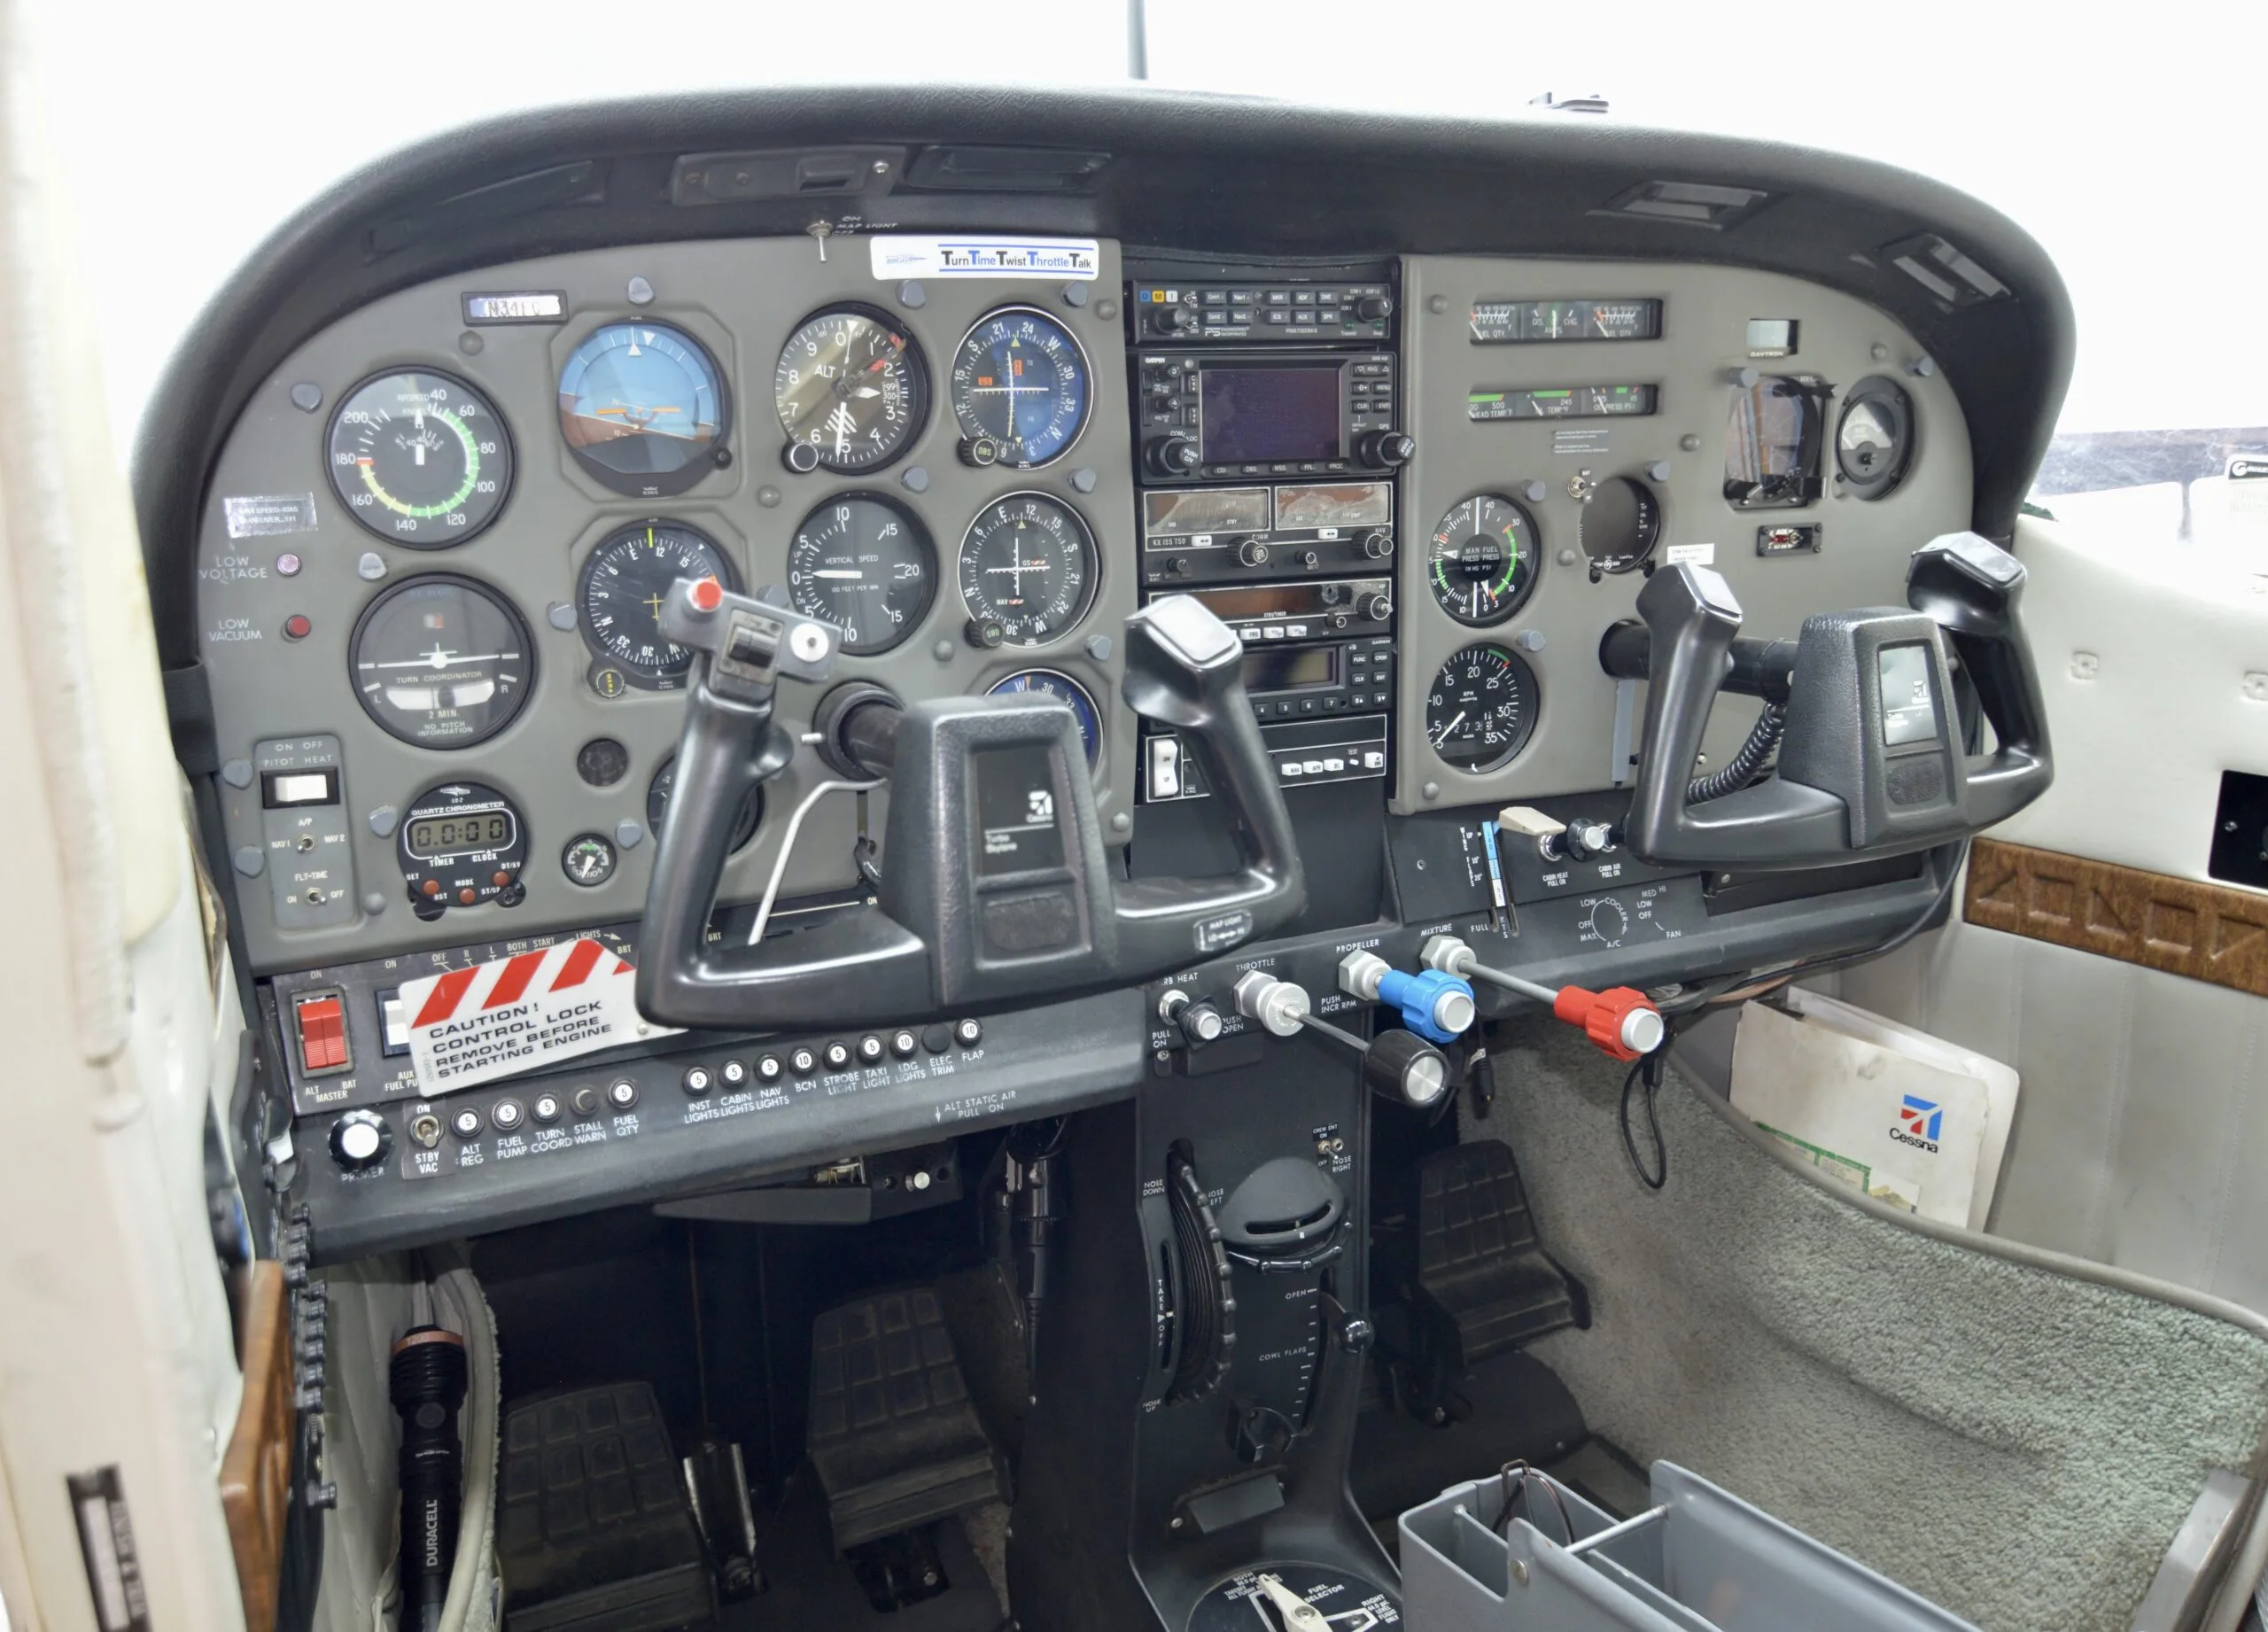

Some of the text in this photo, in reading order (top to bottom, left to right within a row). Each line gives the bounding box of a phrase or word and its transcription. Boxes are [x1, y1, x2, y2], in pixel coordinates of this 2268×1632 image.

[942, 250, 968, 267] Turn
[968, 250, 996, 266] Time
[996, 251, 1026, 267] Twist
[1027, 252, 1069, 267] Throttle
[1068, 253, 1091, 269] Talk
[992, 322, 1034, 335] 21 24
[807, 342, 817, 356] 9
[788, 370, 799, 384] 8
[815, 364, 836, 378] ALT
[430, 389, 447, 400] 40
[460, 405, 475, 416] 60
[344, 411, 369, 424] 200
[480, 442, 496, 454] 80
[978, 447, 991, 456] OBS
[336, 453, 356, 465] 180
[478, 481, 495, 493] 100
[352, 494, 373, 506] 160
[836, 507, 850, 521] 10
[1025, 504, 1037, 515] 12
[396, 519, 416, 531] 140
[447, 514, 466, 525] 120
[886, 524, 897, 536] 15
[215, 556, 249, 567] LOW
[679, 556, 690, 568] 15
[198, 567, 268, 579] VOLTAGE
[905, 563, 920, 577] 20
[218, 618, 250, 629] LOW
[209, 630, 263, 641] VACUUM
[423, 671, 482, 681] COORDINATOR
[1468, 666, 1480, 678] 20
[1445, 675, 1454, 686] 15
[1486, 677, 1499, 689] 25
[375, 695, 381, 703] L
[429, 711, 434, 719] 2
[1496, 706, 1511, 718] 30
[417, 727, 473, 736] INFORMATION
[423, 722, 436, 731] NO
[1484, 732, 1498, 743] 35
[276, 741, 323, 751] ON OFF
[264, 755, 332, 766] PITOT HEAT
[411, 801, 505, 816] QUARTZ CHRONOMETER
[298, 818, 312, 828] A/P
[429, 857, 454, 867] TIMER
[471, 853, 497, 863] CLOCK
[294, 870, 328, 881] FLT-TIME
[407, 873, 419, 882] SET
[330, 890, 345, 899] OFF
[1642, 889, 1657, 898] MED
[1580, 898, 1596, 908] LOW
[1604, 897, 1628, 922] COOLER
[1638, 911, 1652, 920] OFF
[1421, 923, 1453, 936] MIXTURE
[1471, 923, 1489, 933] FULL
[576, 930, 601, 940] LIGHTS
[1666, 930, 1682, 939] FAN
[507, 942, 527, 952] BOTH
[533, 937, 555, 948] START
[1336, 938, 1379, 953] PROPELLER
[1606, 939, 1621, 948] A/C
[617, 944, 632, 954] BRT
[385, 960, 397, 968] ON
[432, 953, 447, 963] OFF
[1236, 958, 1276, 972] THROTTLE
[310, 970, 322, 979] ON
[1177, 973, 1198, 983] HEAT
[1321, 995, 1340, 1006] PUSH
[1321, 999, 1357, 1014] INCR RPM
[430, 1007, 529, 1038] CAUTION
[432, 1000, 602, 1053] CONTROL LOCK
[436, 1016, 601, 1067] REMOVE BEFORE
[439, 1045, 533, 1078] STARTING
[543, 1023, 611, 1049] ENGINE
[961, 1049, 984, 1061] FLAP
[898, 1062, 918, 1072] LDG
[929, 1055, 952, 1067] ELEC
[398, 1070, 415, 1080] AUX
[865, 1068, 887, 1078] TAXI
[932, 1065, 954, 1076] TRIM
[823, 1071, 860, 1086] STROBE
[306, 1079, 356, 1096] ALT BAT
[384, 1080, 404, 1092] FUEL
[760, 1086, 781, 1098] NAV
[795, 1080, 817, 1092] BCN
[316, 1090, 348, 1102] MASTER
[720, 1092, 752, 1106] CABIN
[756, 1095, 790, 1109] LIGHTS
[944, 1091, 1017, 1113] ALT STATIC AIR
[688, 1100, 711, 1112] INST
[720, 1103, 754, 1116] LIGHTS
[959, 1103, 1005, 1118] PULL ON
[613, 1115, 639, 1127] FUEL
[684, 1110, 719, 1123] LIGHTS
[574, 1122, 603, 1134] STALL
[616, 1124, 639, 1137] QTY
[535, 1129, 564, 1140] TURN
[574, 1131, 607, 1145] WARN
[1889, 1127, 1938, 1153] Cessna
[498, 1136, 524, 1147] FUEL
[532, 1138, 572, 1153] COORD
[462, 1143, 480, 1155] ALT
[497, 1146, 528, 1160] PUMP
[415, 1152, 439, 1163] STBY
[461, 1155, 484, 1167] REG
[1332, 1156, 1352, 1166] NOSE
[419, 1162, 438, 1173] VAC
[1332, 1162, 1352, 1173] RIGHT
[1144, 1179, 1163, 1189] NOSE
[1143, 1186, 1165, 1196] DOWN
[1285, 1288, 1307, 1300] OPEN
[1259, 1346, 1307, 1362] COWL FLAPS
[1142, 1398, 1161, 1409] NOSE
[426, 1499, 438, 1566] DURACELL
[1303, 1584, 1345, 1603] SELECTOR
[1308, 1584, 1328, 1595] FUEL
[1362, 1594, 1386, 1606] RIGHT
